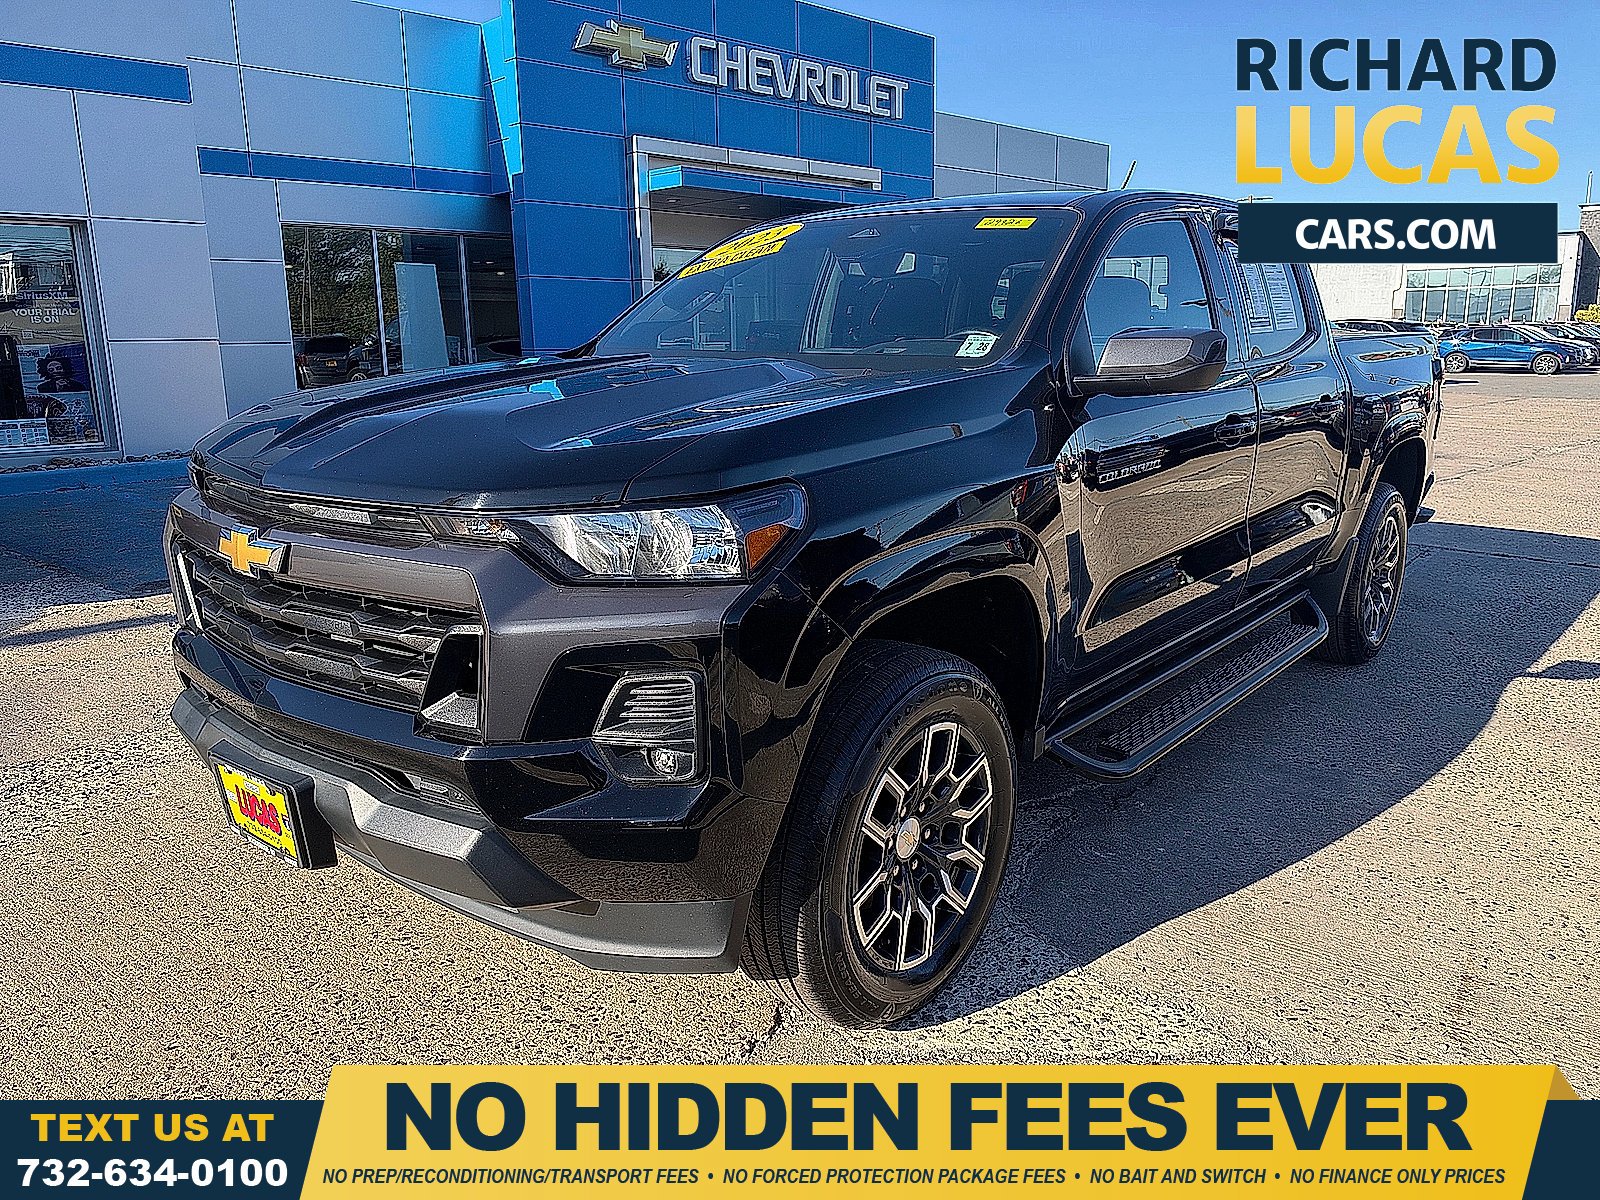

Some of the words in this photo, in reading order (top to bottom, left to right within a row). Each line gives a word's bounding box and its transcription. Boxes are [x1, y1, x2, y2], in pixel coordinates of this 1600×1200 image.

[688, 36, 909, 119] CHEVROLET
[685, 254, 731, 276] EXTRA
[730, 243, 777, 262] CLEAN
[15, 291, 69, 300] SiriusXM
[12, 308, 43, 316] YOUR
[44, 308, 76, 316] TRIAL
[30, 316, 42, 324] IS
[43, 316, 60, 324] ON
[1098, 459, 1162, 484] COLORADO
[234, 783, 283, 837] LUCAS
